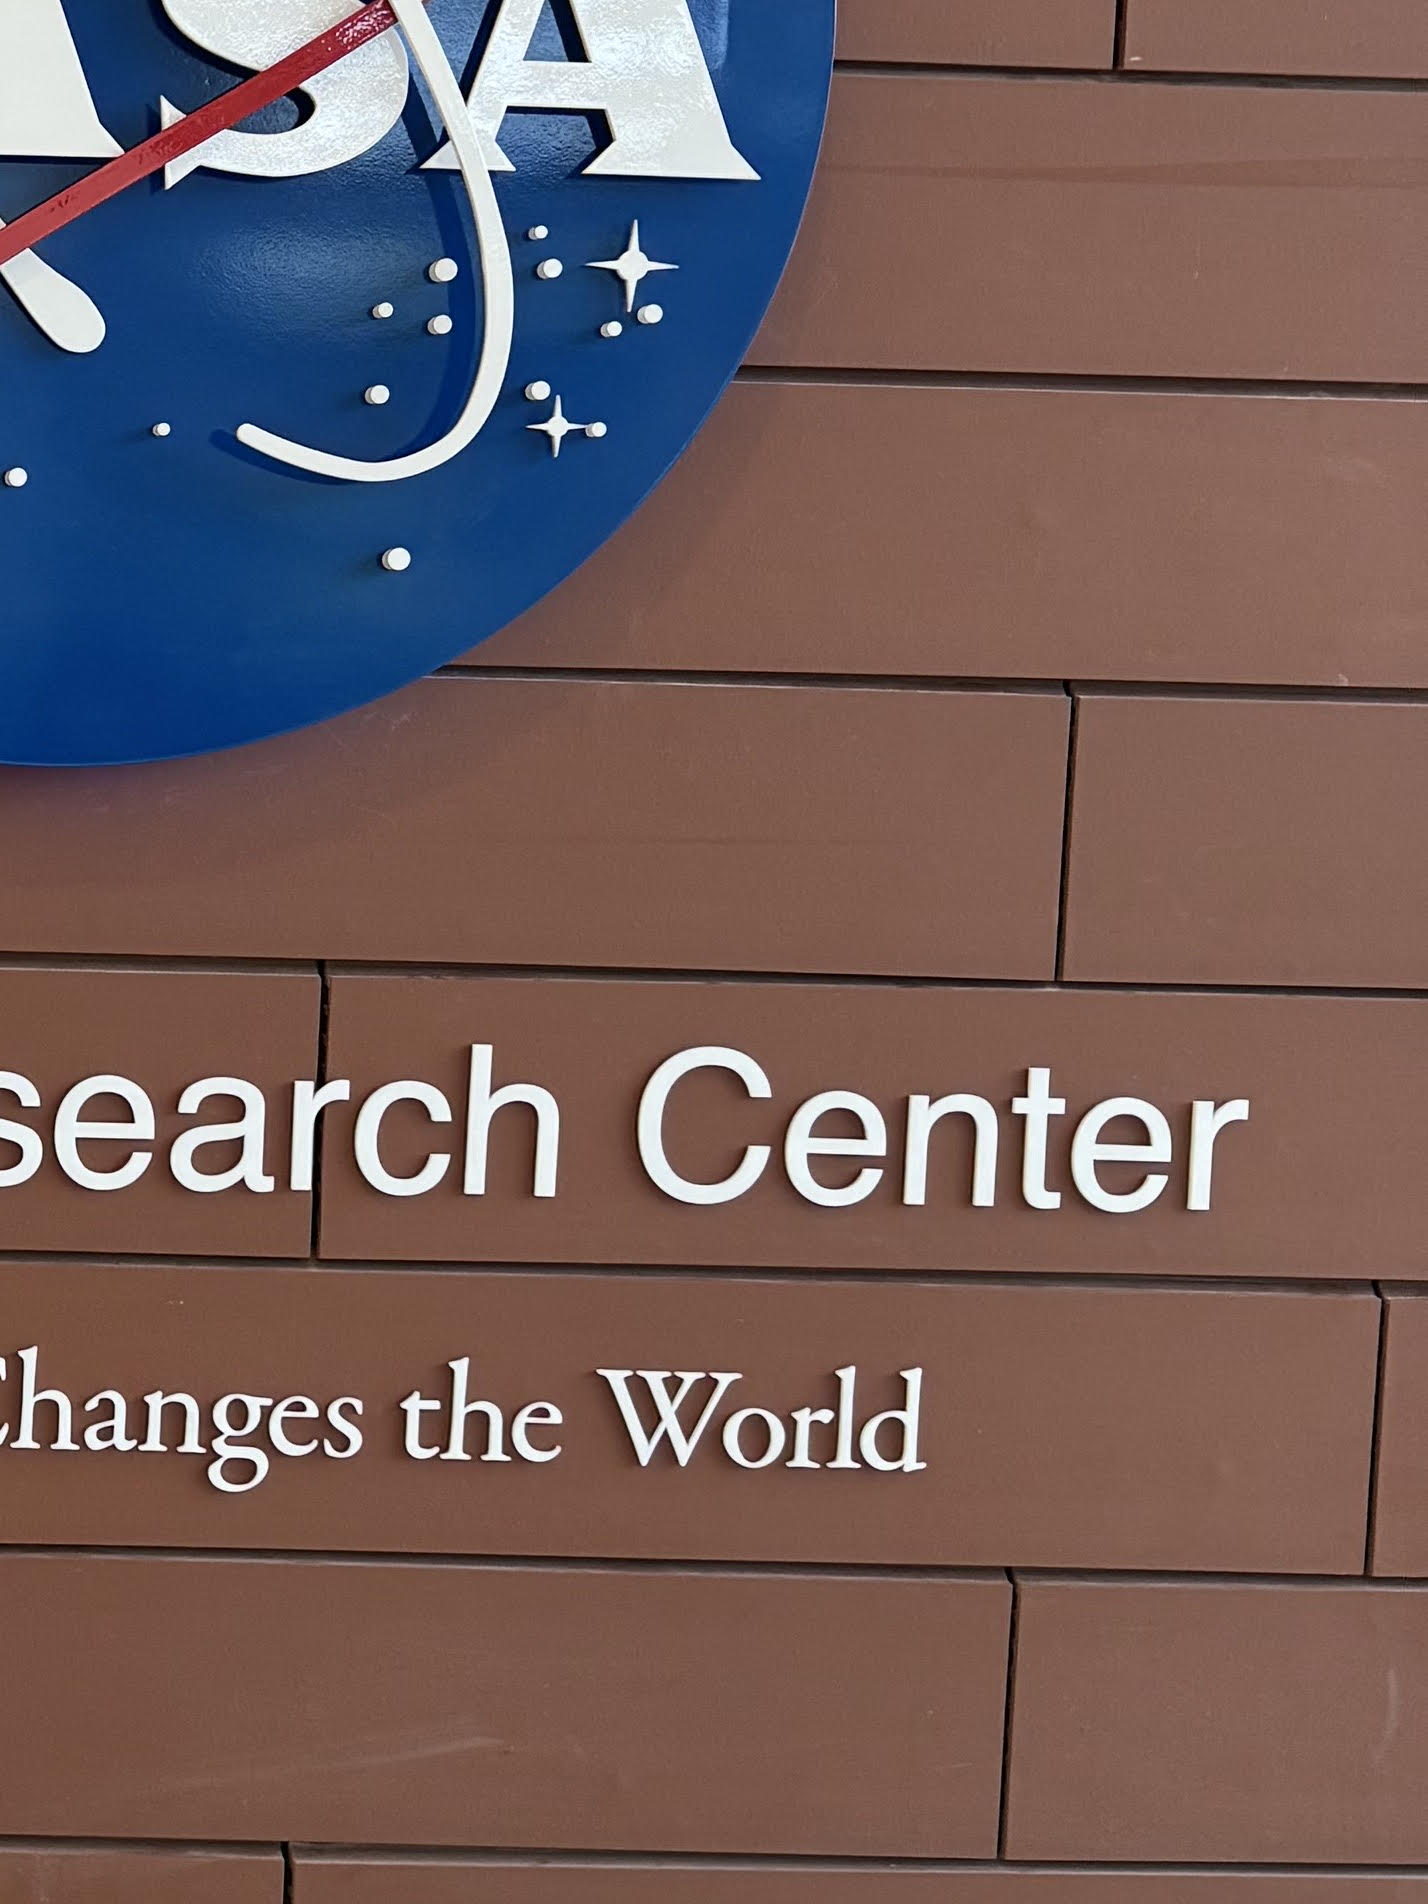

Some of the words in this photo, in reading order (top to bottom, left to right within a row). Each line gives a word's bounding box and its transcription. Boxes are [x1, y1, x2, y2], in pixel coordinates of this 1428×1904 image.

[638, 1046, 1250, 1213] Center
[399, 1356, 563, 1463] the
[596, 1365, 927, 1473] World
